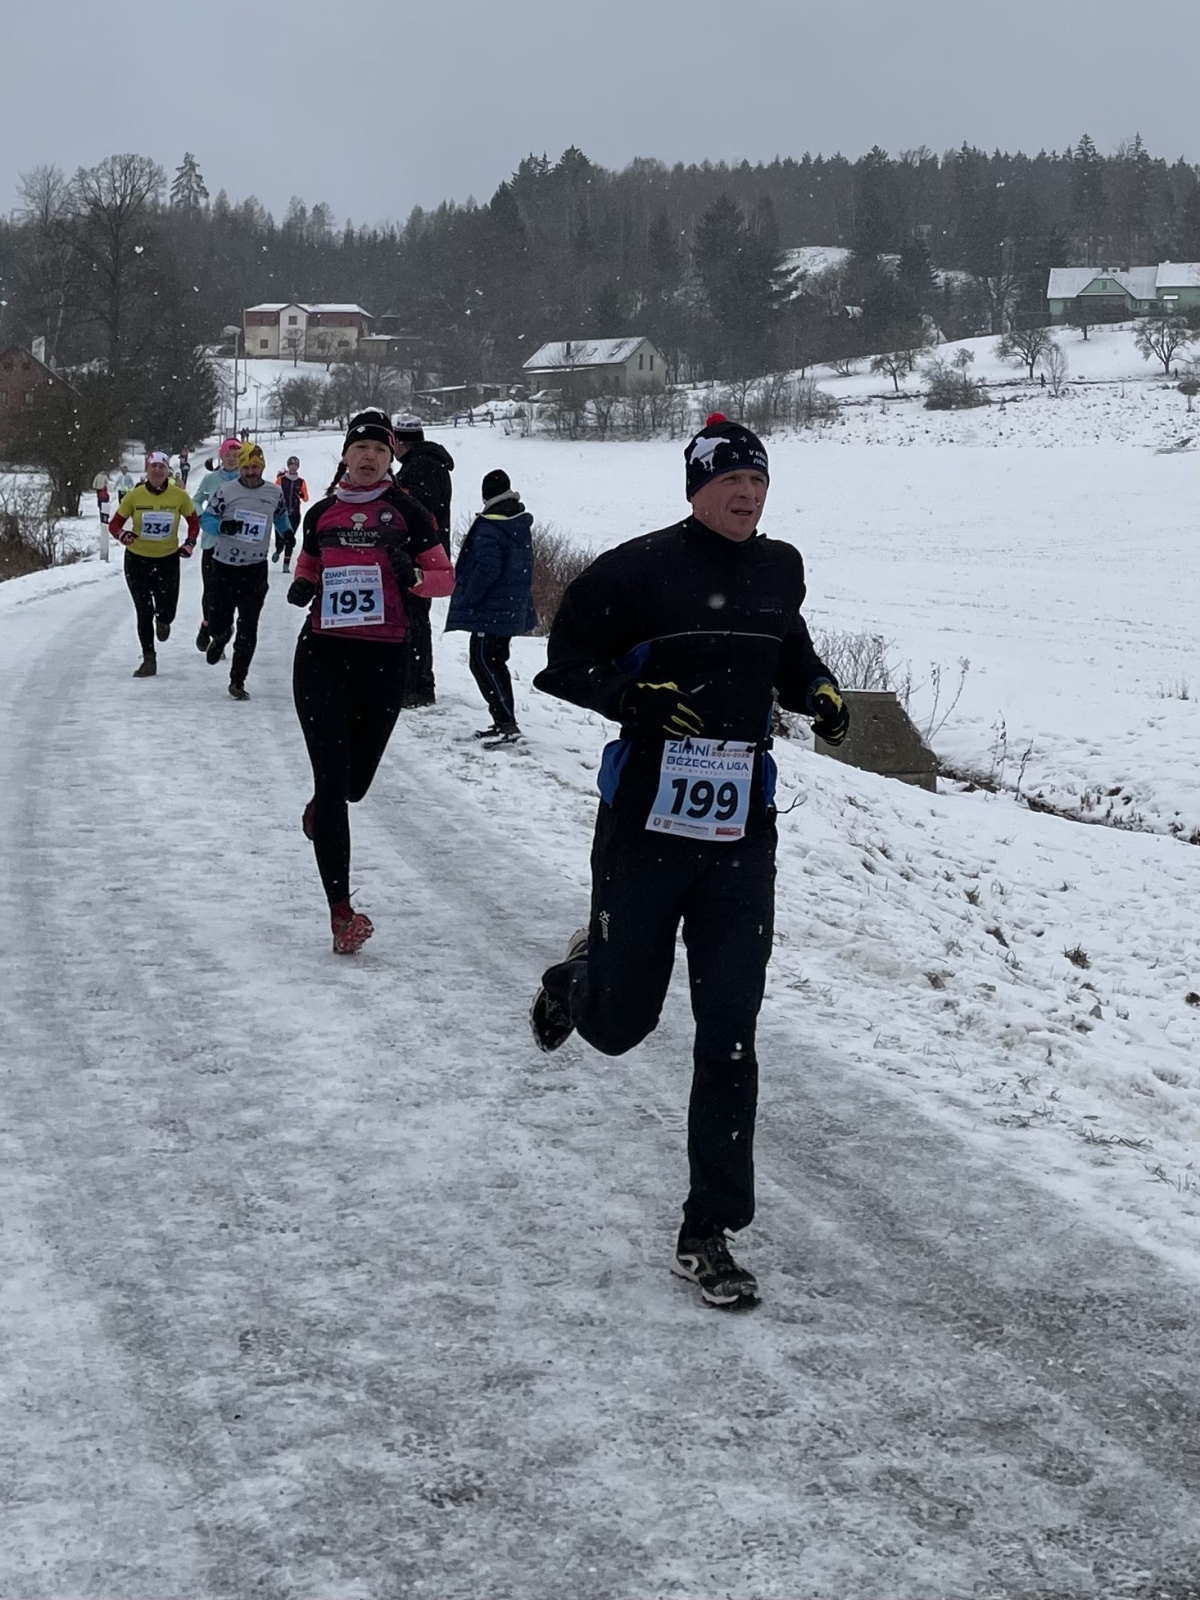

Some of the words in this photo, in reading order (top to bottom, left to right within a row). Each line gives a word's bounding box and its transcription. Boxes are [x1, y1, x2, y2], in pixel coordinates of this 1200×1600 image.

[143, 523, 171, 535] 234
[337, 530, 381, 539] GLADIATOR
[329, 589, 376, 615] 193
[668, 742, 711, 757] ZIMNÍ
[670, 778, 739, 821] 199
